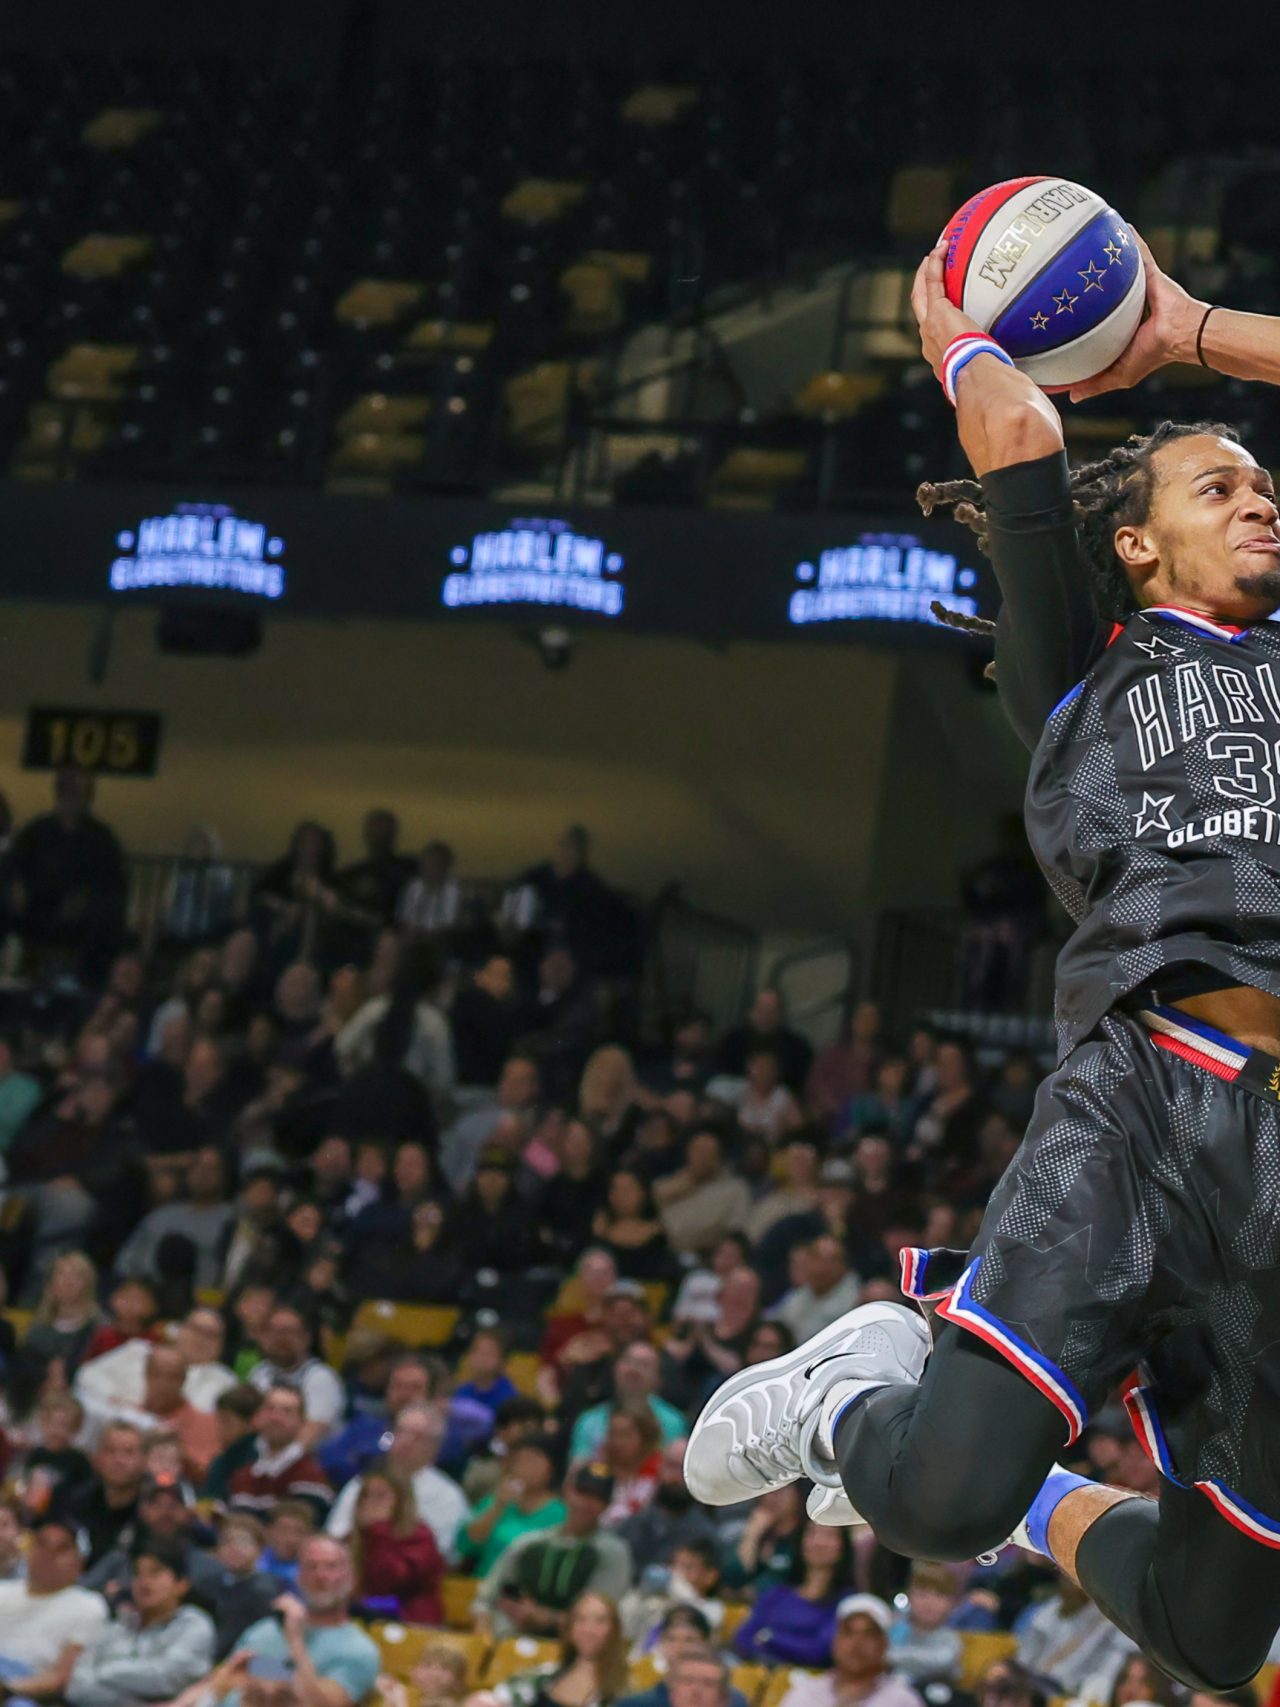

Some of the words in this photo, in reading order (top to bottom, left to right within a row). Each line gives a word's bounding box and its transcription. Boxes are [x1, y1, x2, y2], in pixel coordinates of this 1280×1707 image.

[978, 184, 1093, 289] HARLEM
[137, 514, 265, 559] HARLEM
[470, 529, 605, 575] HARLEM
[50, 719, 138, 768] 105
